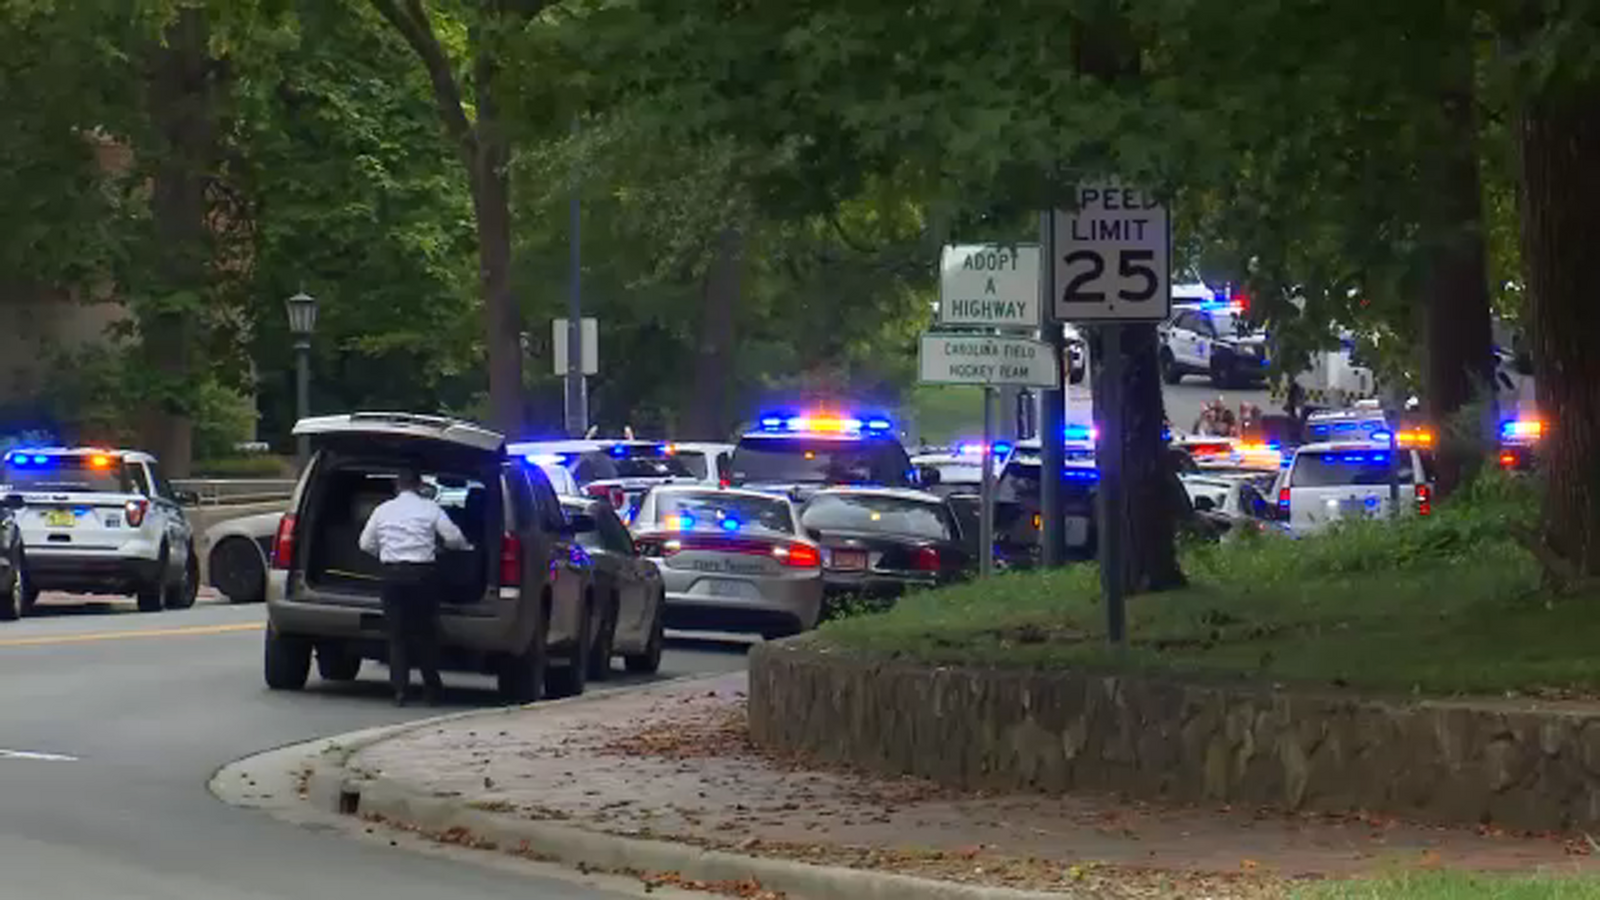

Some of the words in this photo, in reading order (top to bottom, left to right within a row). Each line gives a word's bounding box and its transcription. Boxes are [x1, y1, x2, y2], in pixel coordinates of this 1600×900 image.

[1070, 187, 1159, 210] PEED
[1072, 219, 1148, 240] LIMIT
[963, 252, 1018, 271] ADOPT
[1063, 249, 1158, 302] 25
[985, 278, 996, 294] A
[951, 299, 1026, 319] HIGHWAY
[944, 342, 998, 357] CAROLINA
[1004, 344, 1035, 359] FIELD
[949, 364, 993, 377] HOCKEY
